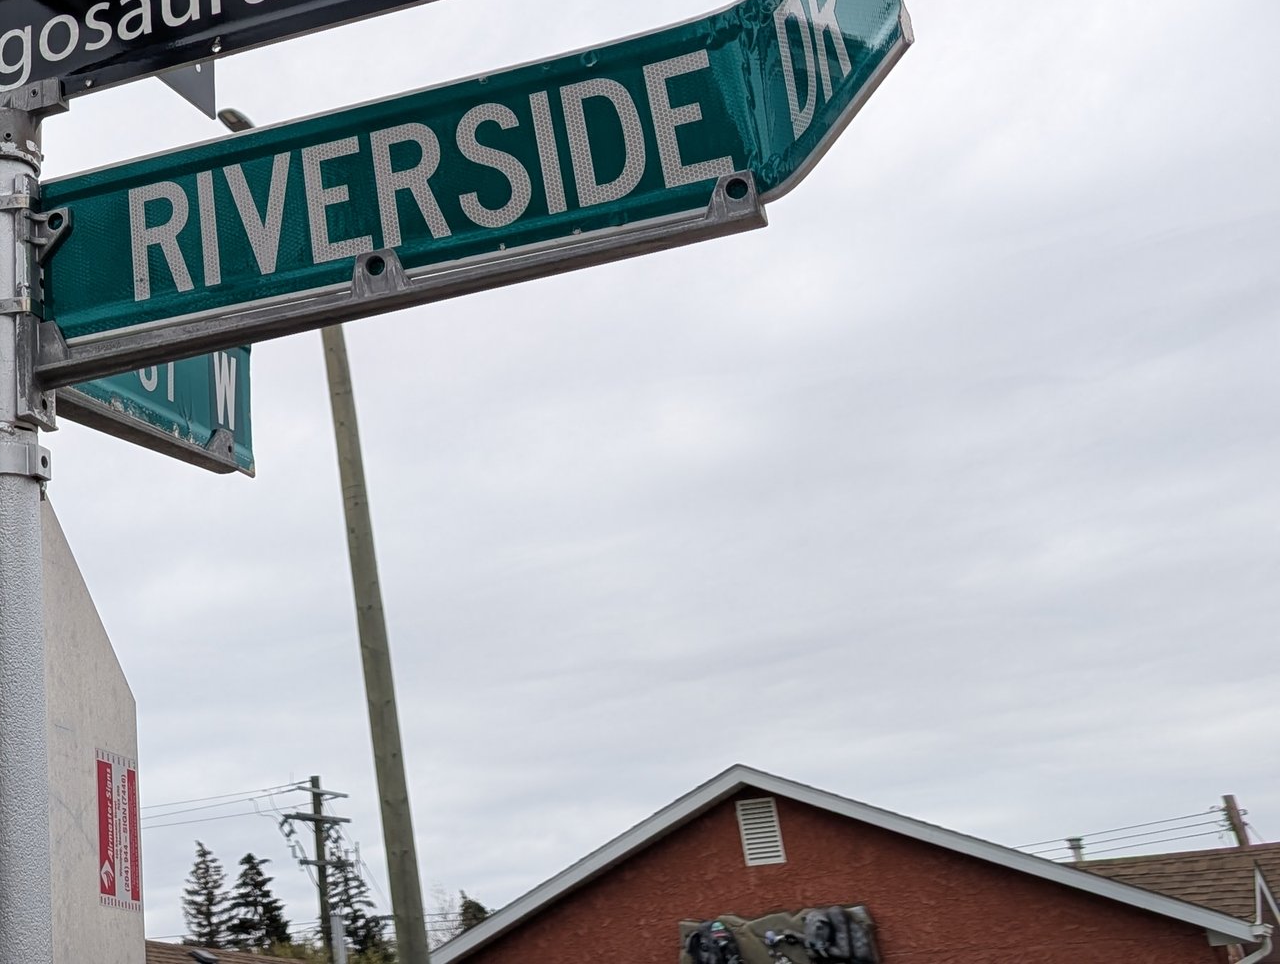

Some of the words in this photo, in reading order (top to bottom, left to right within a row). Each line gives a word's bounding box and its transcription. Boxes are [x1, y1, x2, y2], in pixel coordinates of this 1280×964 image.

[127, 49, 735, 302] RIVERSIDE
[212, 351, 237, 431] W
[105, 767, 113, 799] Signs
